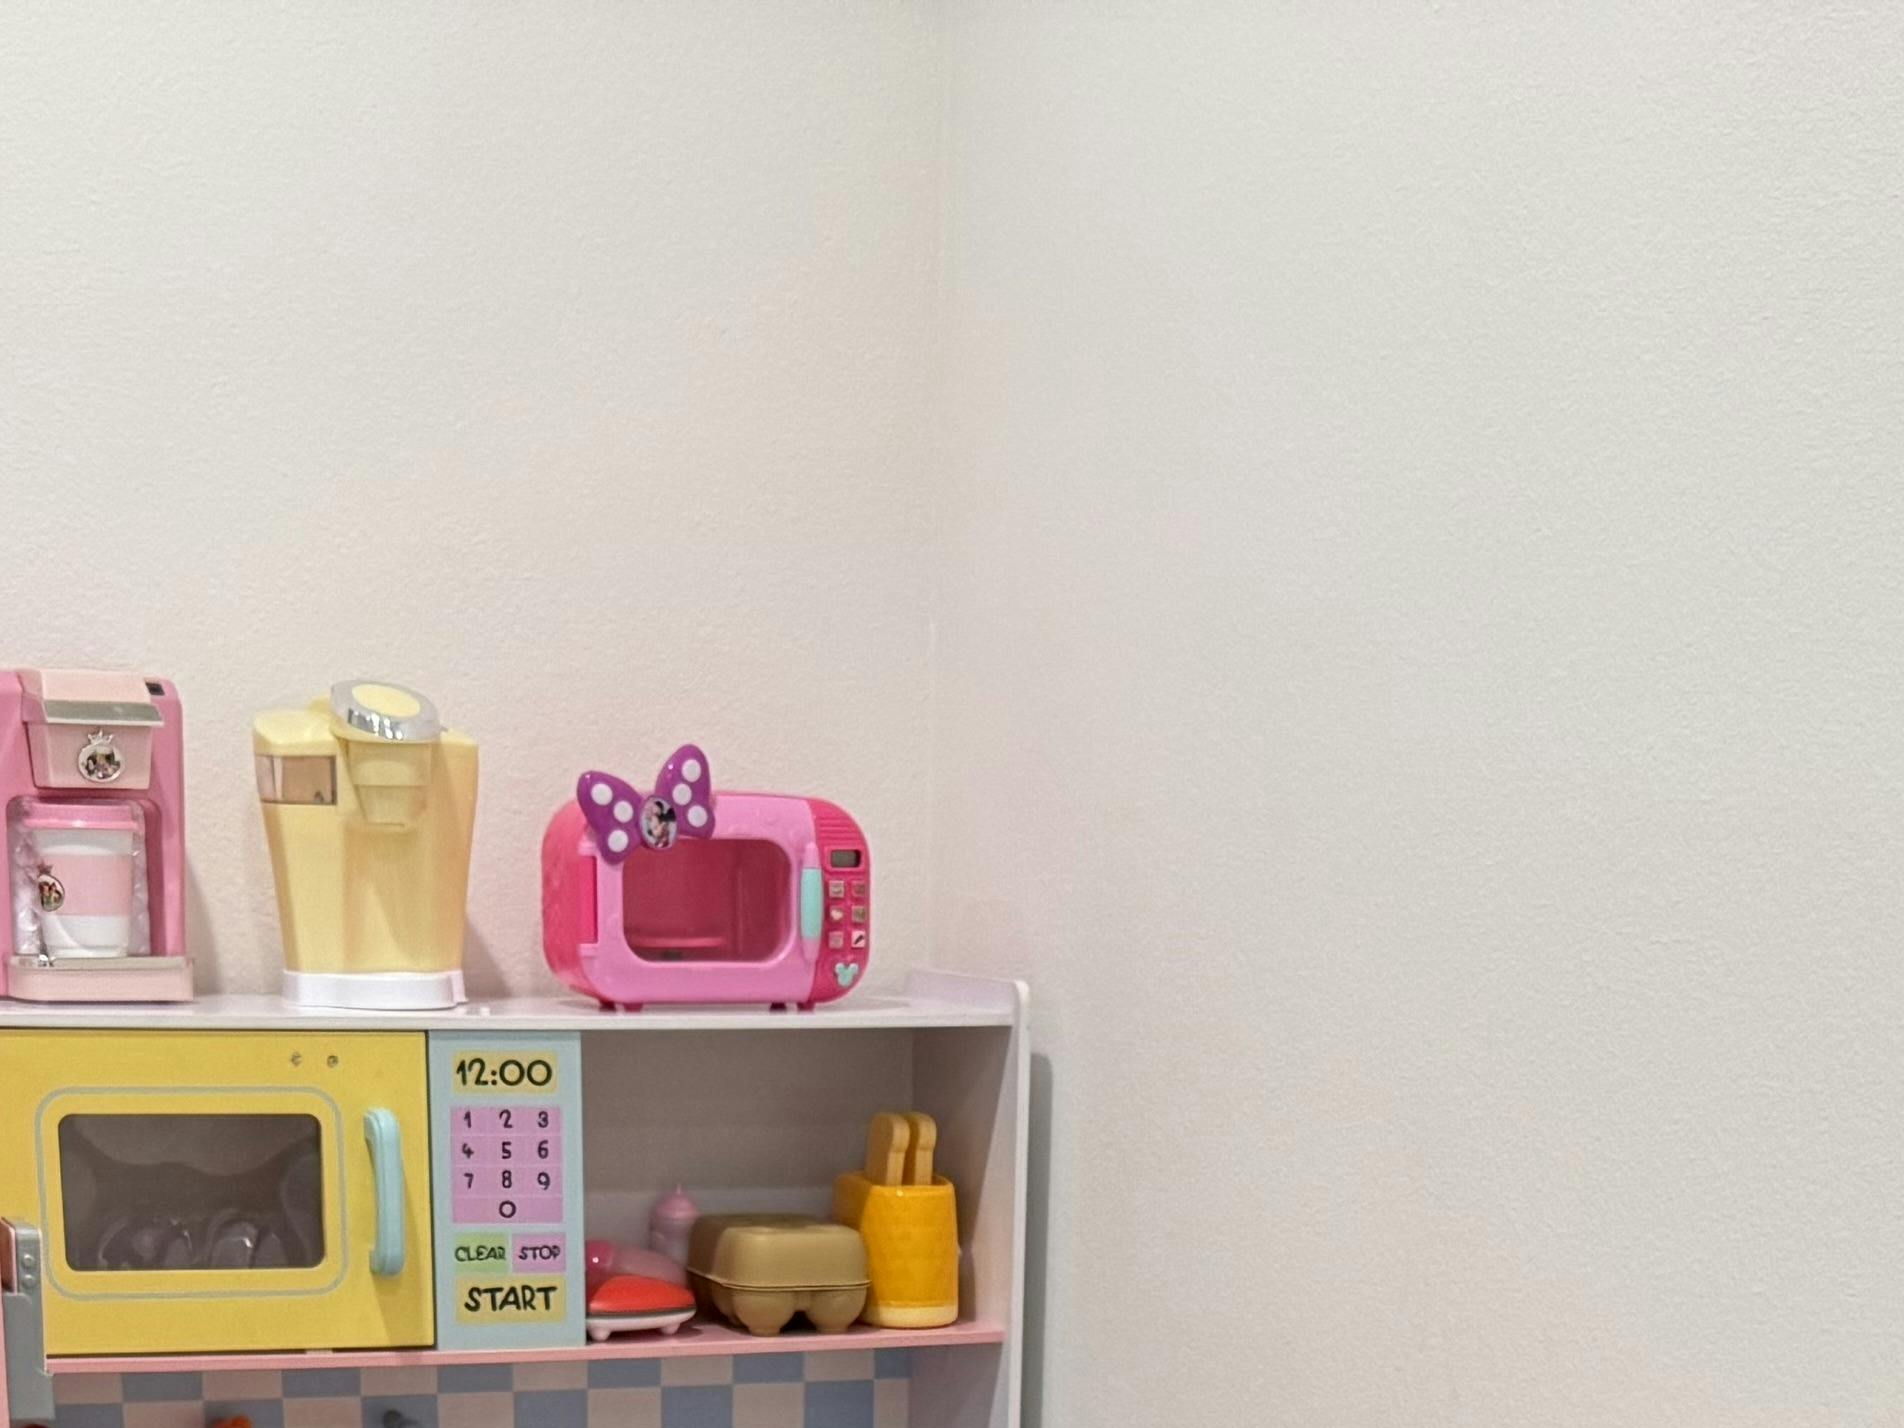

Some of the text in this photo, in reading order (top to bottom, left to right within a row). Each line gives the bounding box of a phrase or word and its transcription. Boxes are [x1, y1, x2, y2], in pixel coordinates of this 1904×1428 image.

[456, 1057, 552, 1086] 12:00
[463, 1109, 549, 1128] 1 2 3
[461, 1140, 549, 1159] 4 5 6
[463, 1169, 551, 1190] 7 8 9
[454, 1245, 506, 1262] CLEAR
[518, 1245, 561, 1260] STOP
[464, 1285, 558, 1312] START
